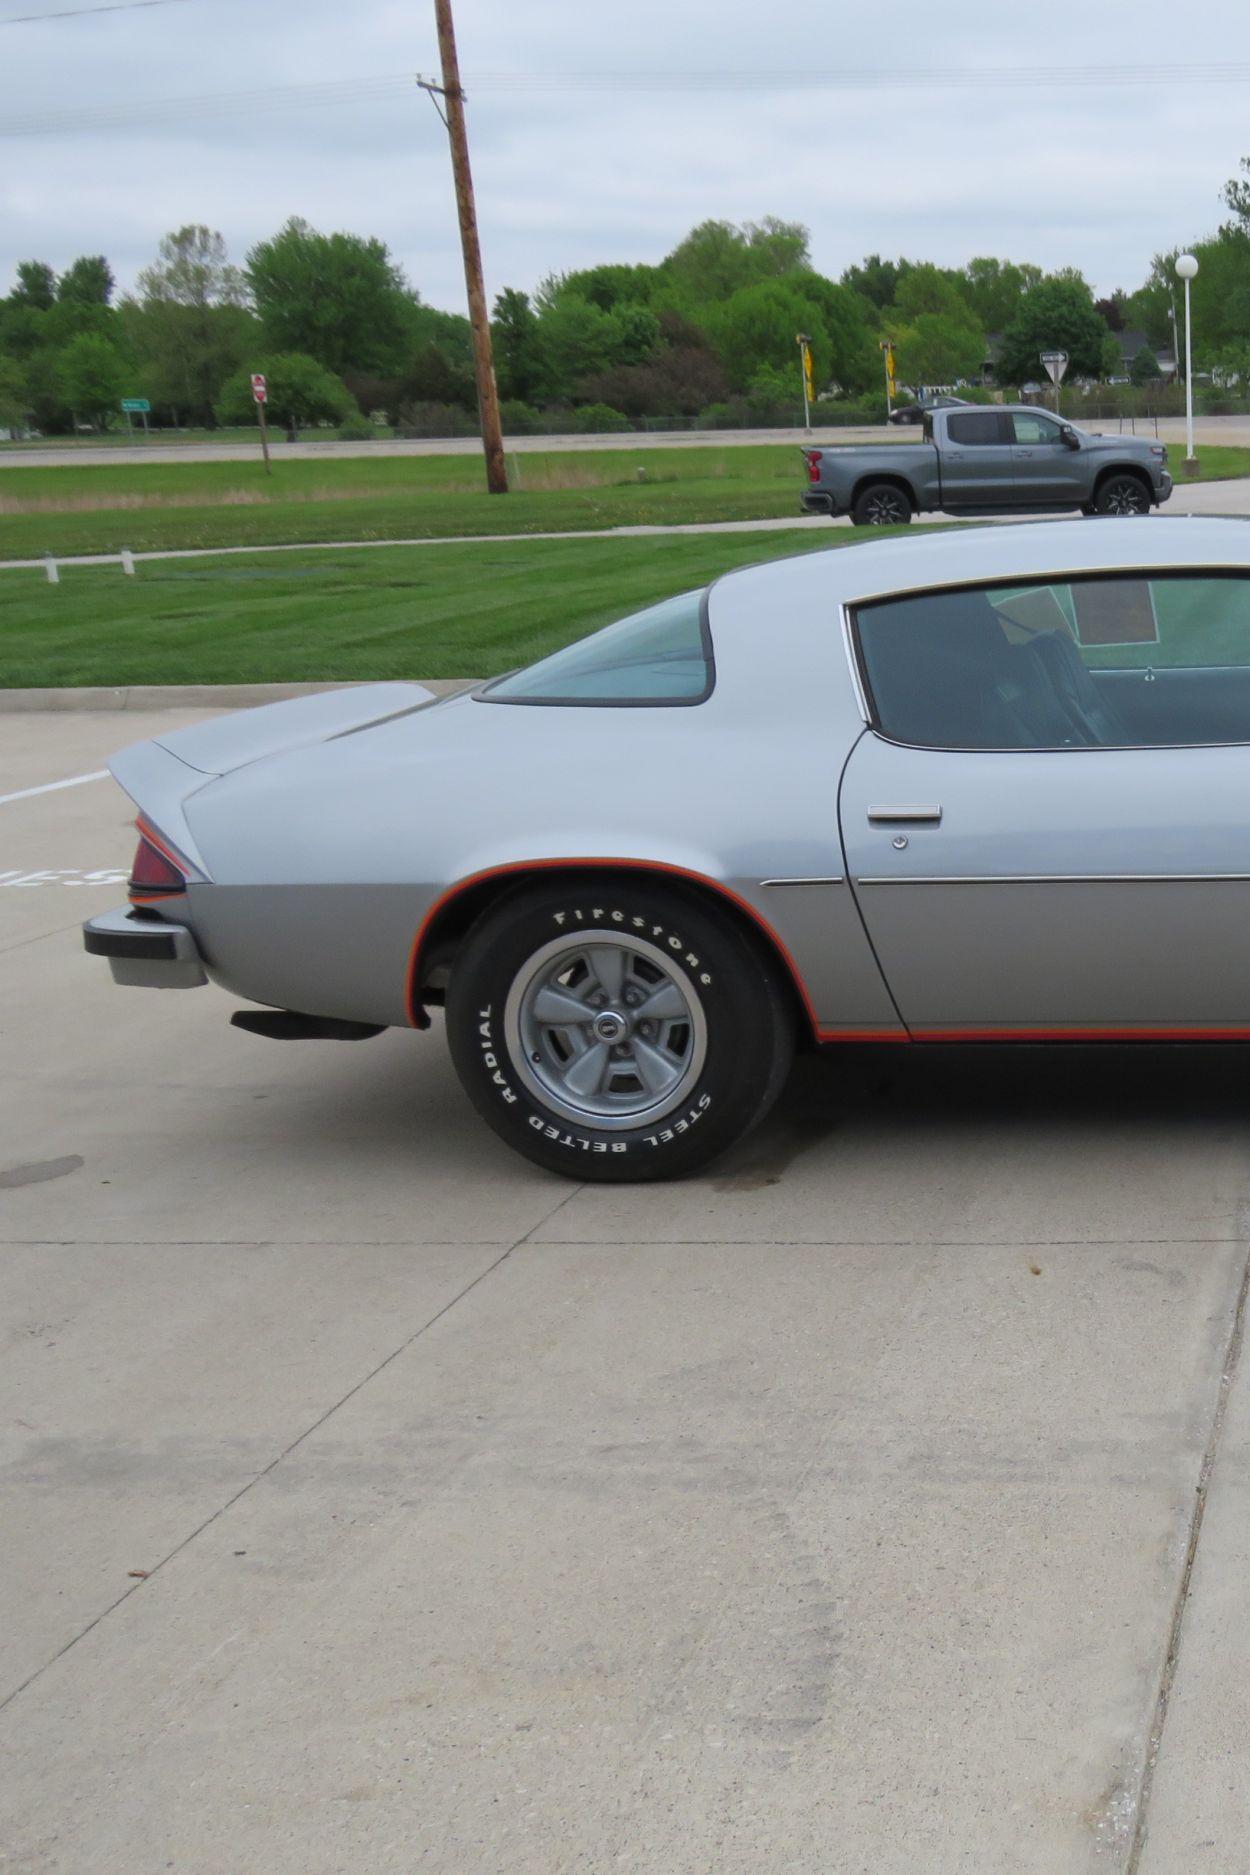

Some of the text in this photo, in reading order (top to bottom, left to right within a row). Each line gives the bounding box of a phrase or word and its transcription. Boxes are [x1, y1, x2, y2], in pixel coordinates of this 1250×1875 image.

[478, 1004, 712, 1153] STEEL BELTED RADIAL
